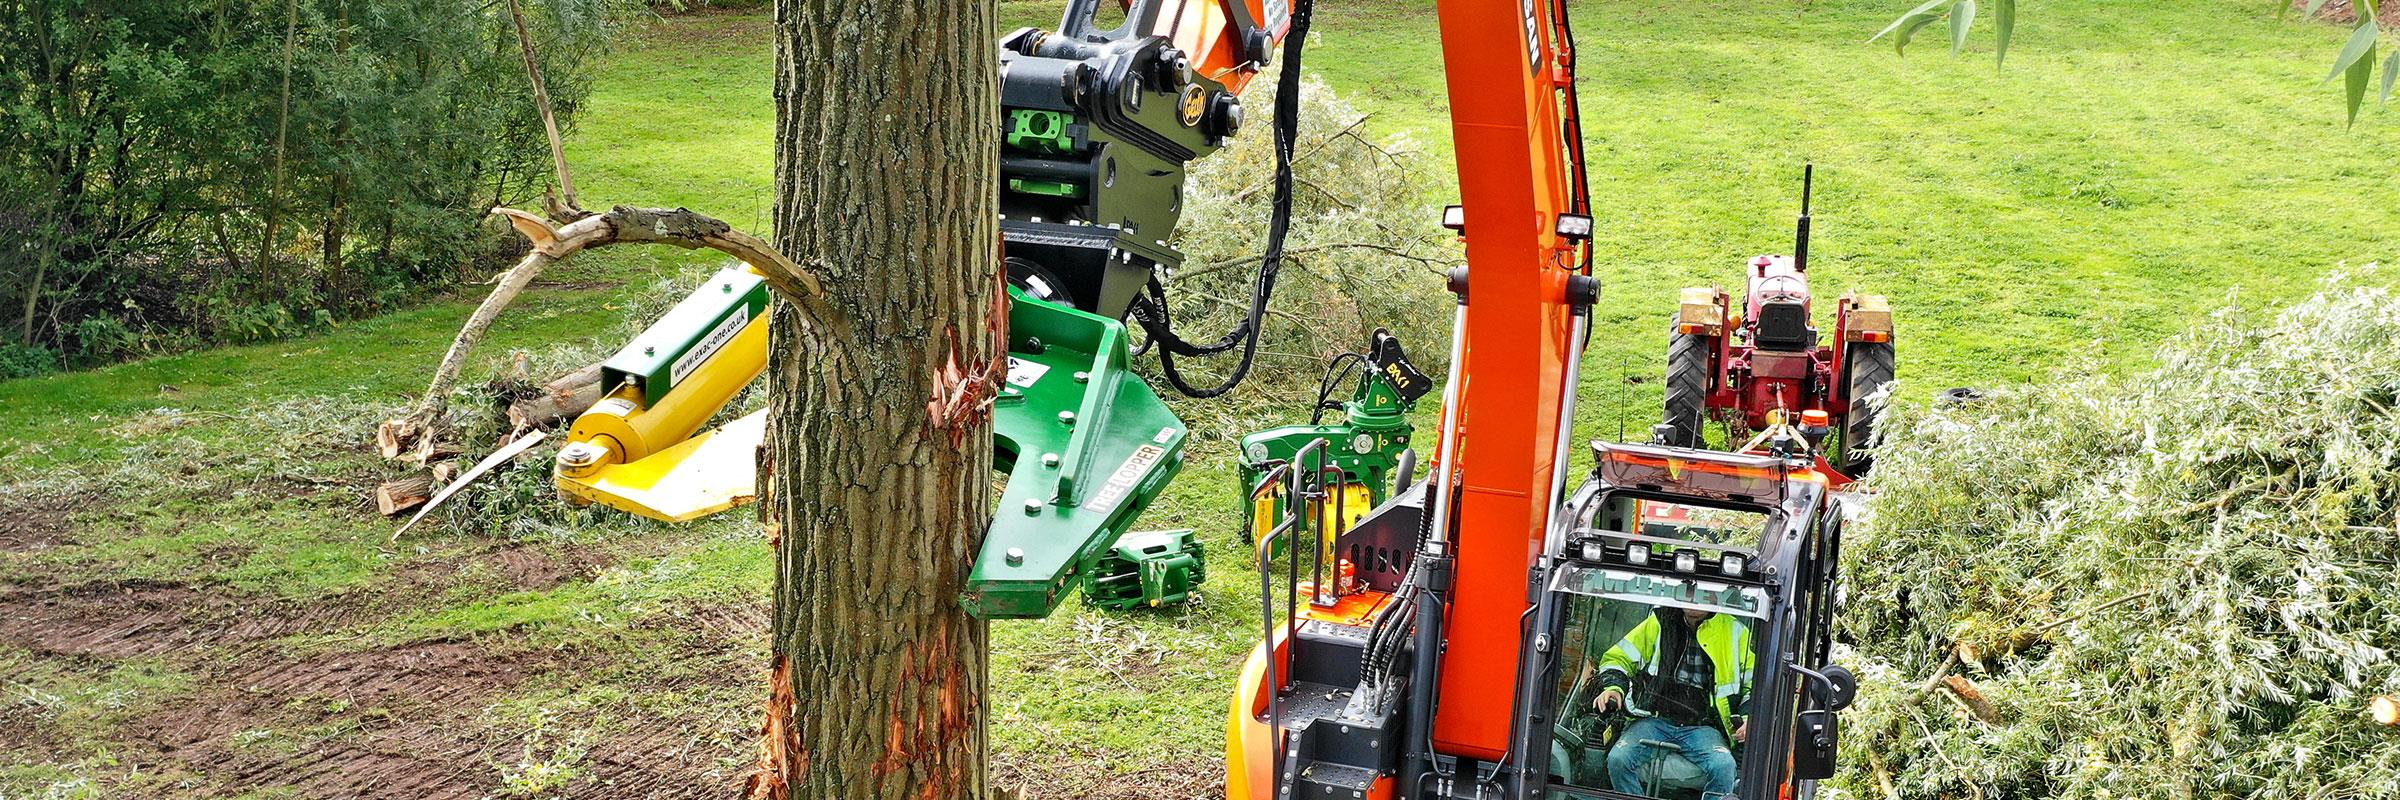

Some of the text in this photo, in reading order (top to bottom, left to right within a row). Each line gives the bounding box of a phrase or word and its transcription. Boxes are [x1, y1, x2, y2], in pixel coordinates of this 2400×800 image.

[674, 310, 746, 377] www.exac-one.co.uk
[1085, 446, 1160, 510] TREE LOPPER
